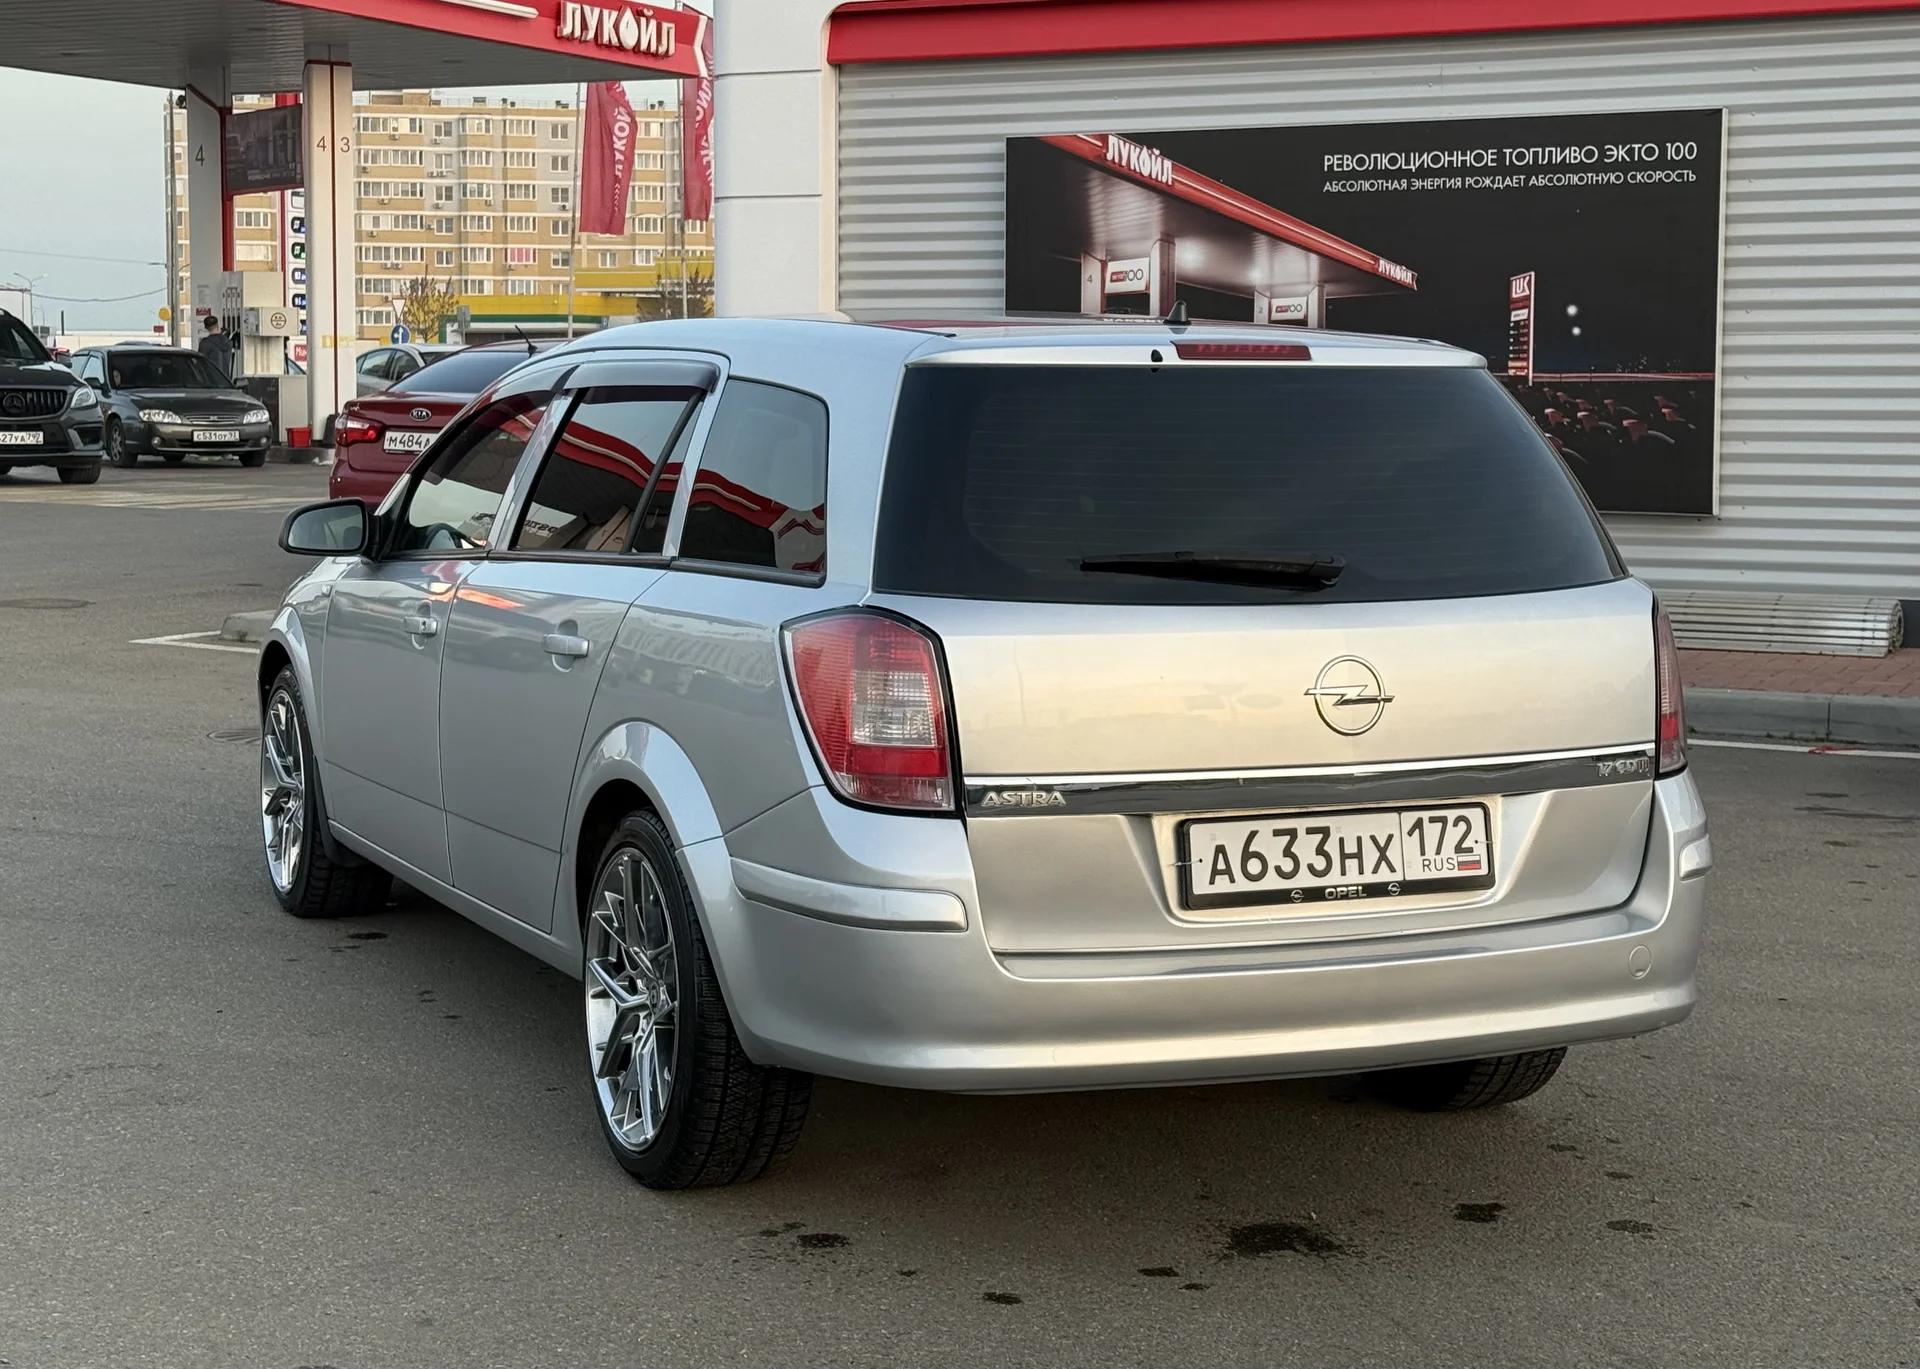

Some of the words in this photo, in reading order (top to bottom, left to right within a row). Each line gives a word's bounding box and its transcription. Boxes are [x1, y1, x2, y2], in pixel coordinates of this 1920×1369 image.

[557, 2, 675, 57] ЛУКОЙЛ
[316, 136, 327, 153] 4
[340, 137, 350, 153] 3
[195, 144, 205, 167] 4
[1106, 134, 1172, 185] ЛУКОЙЛ
[1324, 149, 1497, 172] РЕВОЛЮЦИОННОЕ
[1503, 145, 1599, 166] ТОПЛИВО
[1604, 143, 1659, 163] ЭКТО
[1666, 142, 1697, 161] 100
[1323, 178, 1408, 193] АБСОЛЮТНАЯ
[1410, 177, 1462, 190] ЭНЕРГИЯ
[1465, 175, 1526, 190] РОЖДАЕТ
[1528, 172, 1624, 187] АБСОЛЮТНУЮ
[1627, 170, 1696, 184] СКОРОСТЬ
[412, 410, 428, 419] KIA
[981, 791, 1066, 807] ASTRA
[1208, 825, 1397, 885] А633НХ
[1407, 815, 1475, 856] 172
[1423, 857, 1456, 873] RUS
[1324, 886, 1367, 899] OPEL
